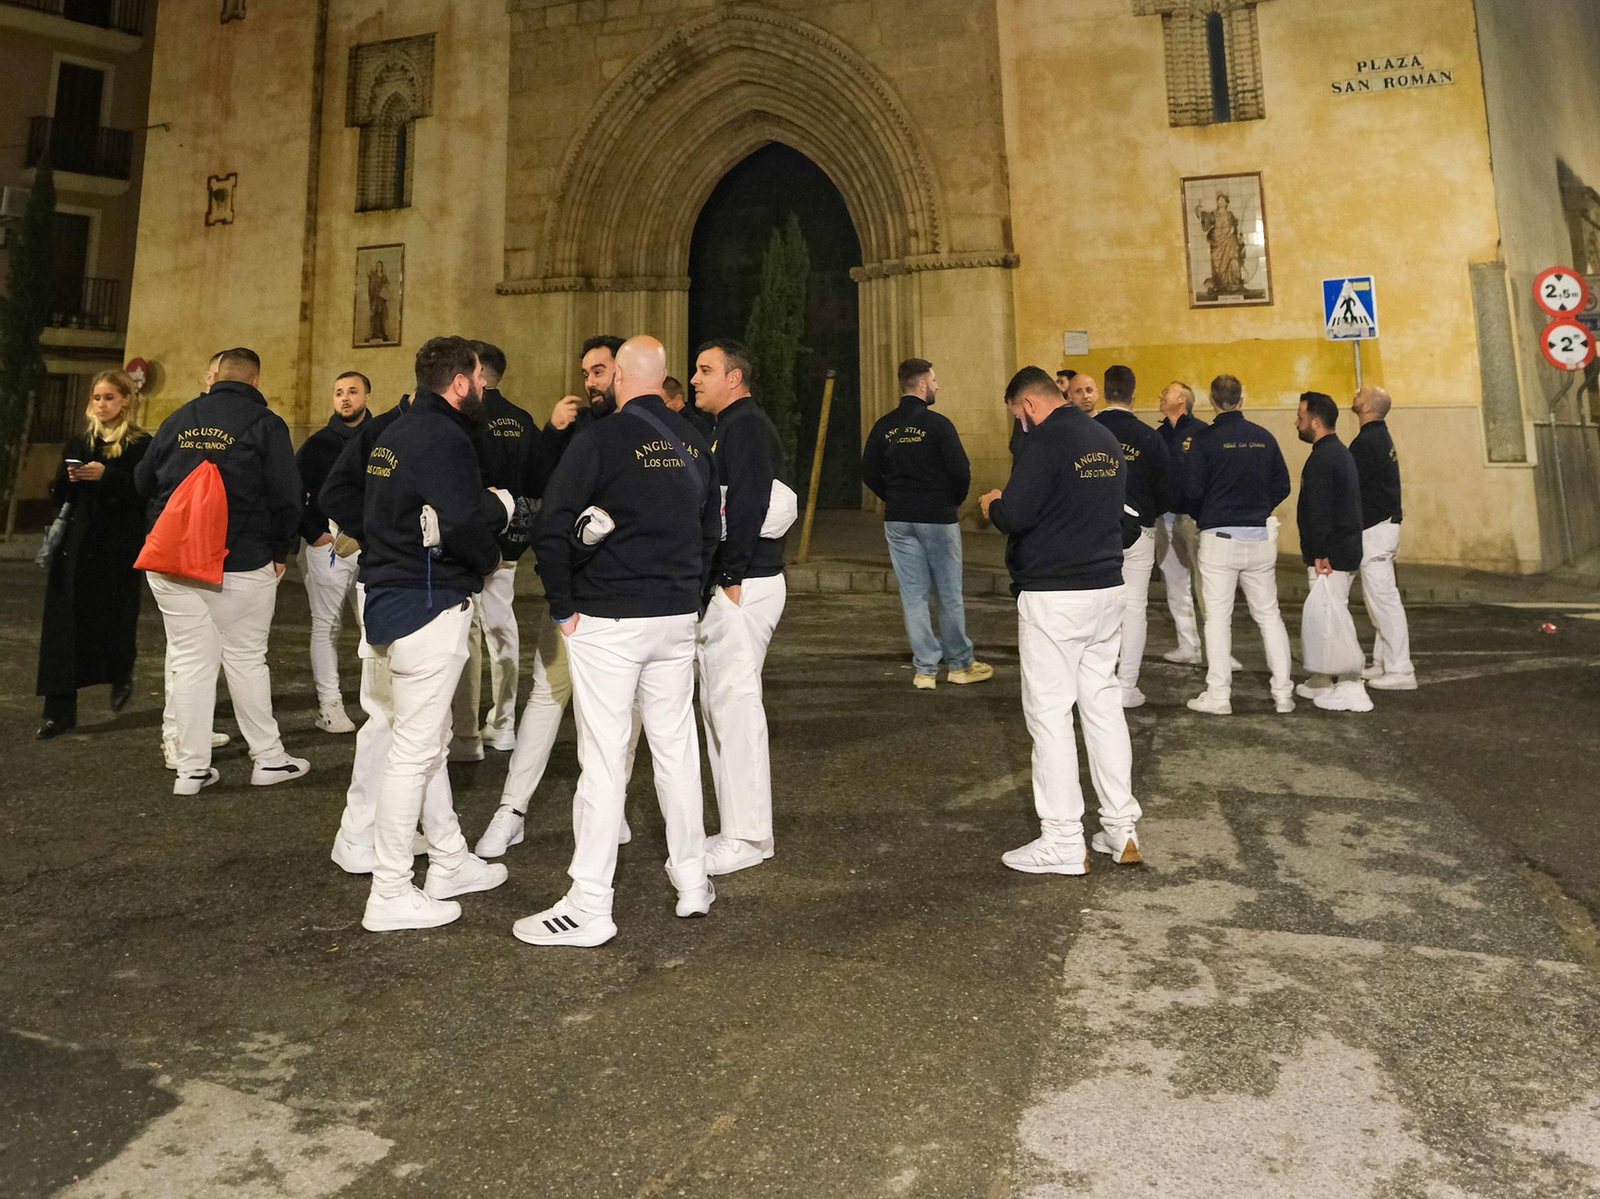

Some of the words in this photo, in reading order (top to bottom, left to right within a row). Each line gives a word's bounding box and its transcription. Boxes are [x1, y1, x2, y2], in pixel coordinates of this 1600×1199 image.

[1357, 55, 1422, 72] PLAZA
[1331, 79, 1370, 93] SAN
[1383, 71, 1452, 89] ROMAN
[177, 428, 235, 445] ANGUSTIAS
[180, 441, 195, 449] LOS
[195, 441, 226, 450] GTANOS
[635, 440, 700, 460] ANGUSAS
[644, 459, 660, 467] LOS
[662, 459, 686, 467] GITAN
[1074, 452, 1120, 471] ANGUSTIAS
[1080, 470, 1092, 478] LOS
